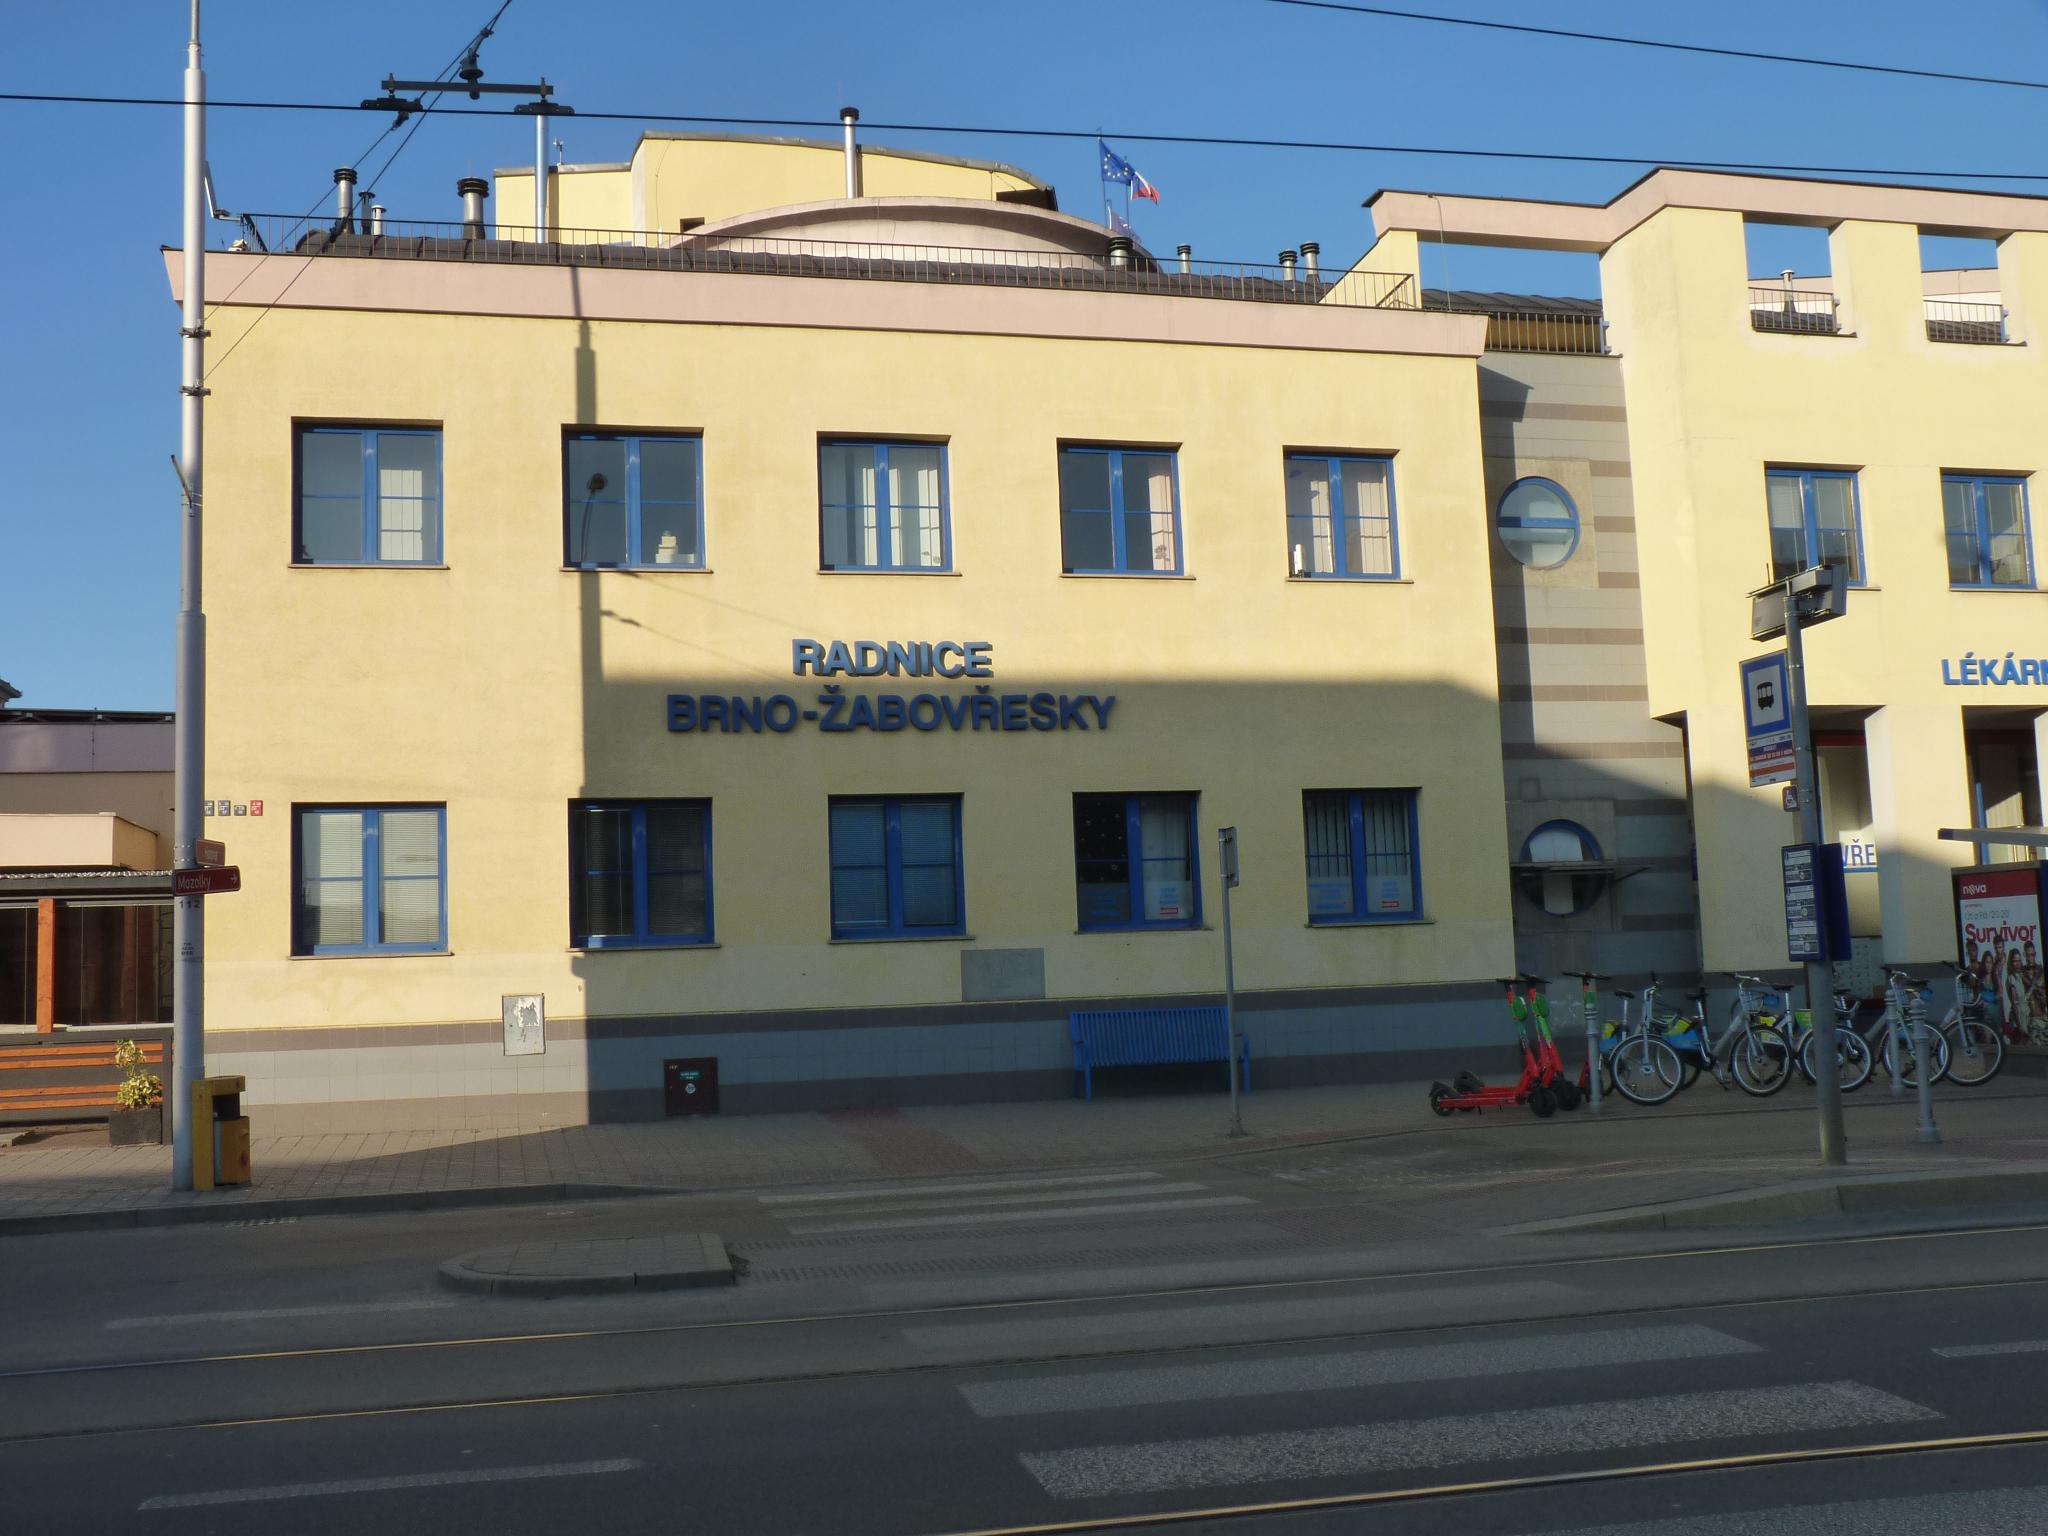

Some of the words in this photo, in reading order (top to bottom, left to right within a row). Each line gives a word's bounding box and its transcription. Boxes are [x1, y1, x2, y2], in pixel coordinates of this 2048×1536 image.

[792, 639, 993, 678] RADNICE
[667, 684, 1116, 732] BRNO-ŽABOVŘESKY
[177, 874, 212, 890] Mozolky
[1963, 884, 1987, 895] nova
[179, 900, 200, 909] 112
[1965, 921, 2037, 943] Survivor
